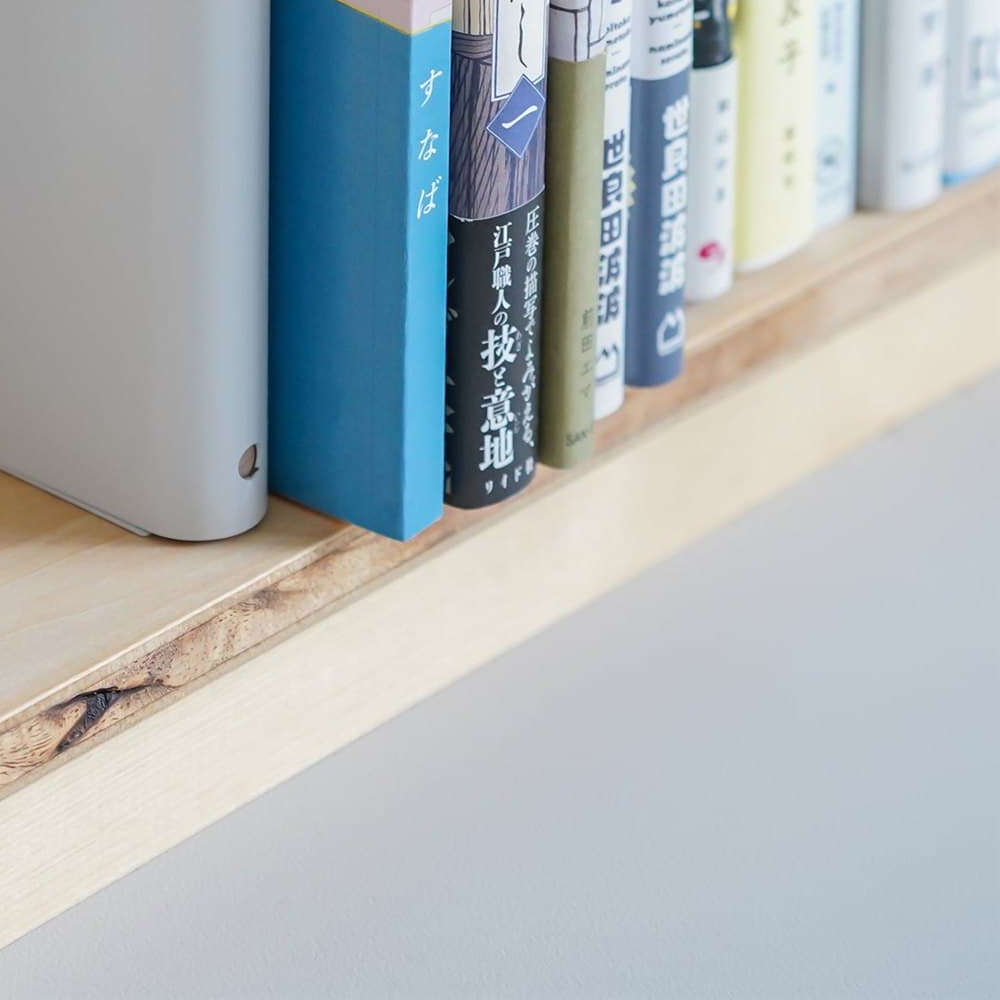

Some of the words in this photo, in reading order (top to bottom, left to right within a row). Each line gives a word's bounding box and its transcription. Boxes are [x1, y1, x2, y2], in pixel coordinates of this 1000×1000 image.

[416, 68, 443, 220] すなば
[478, 222, 520, 472] 江戸職人の技と意地
